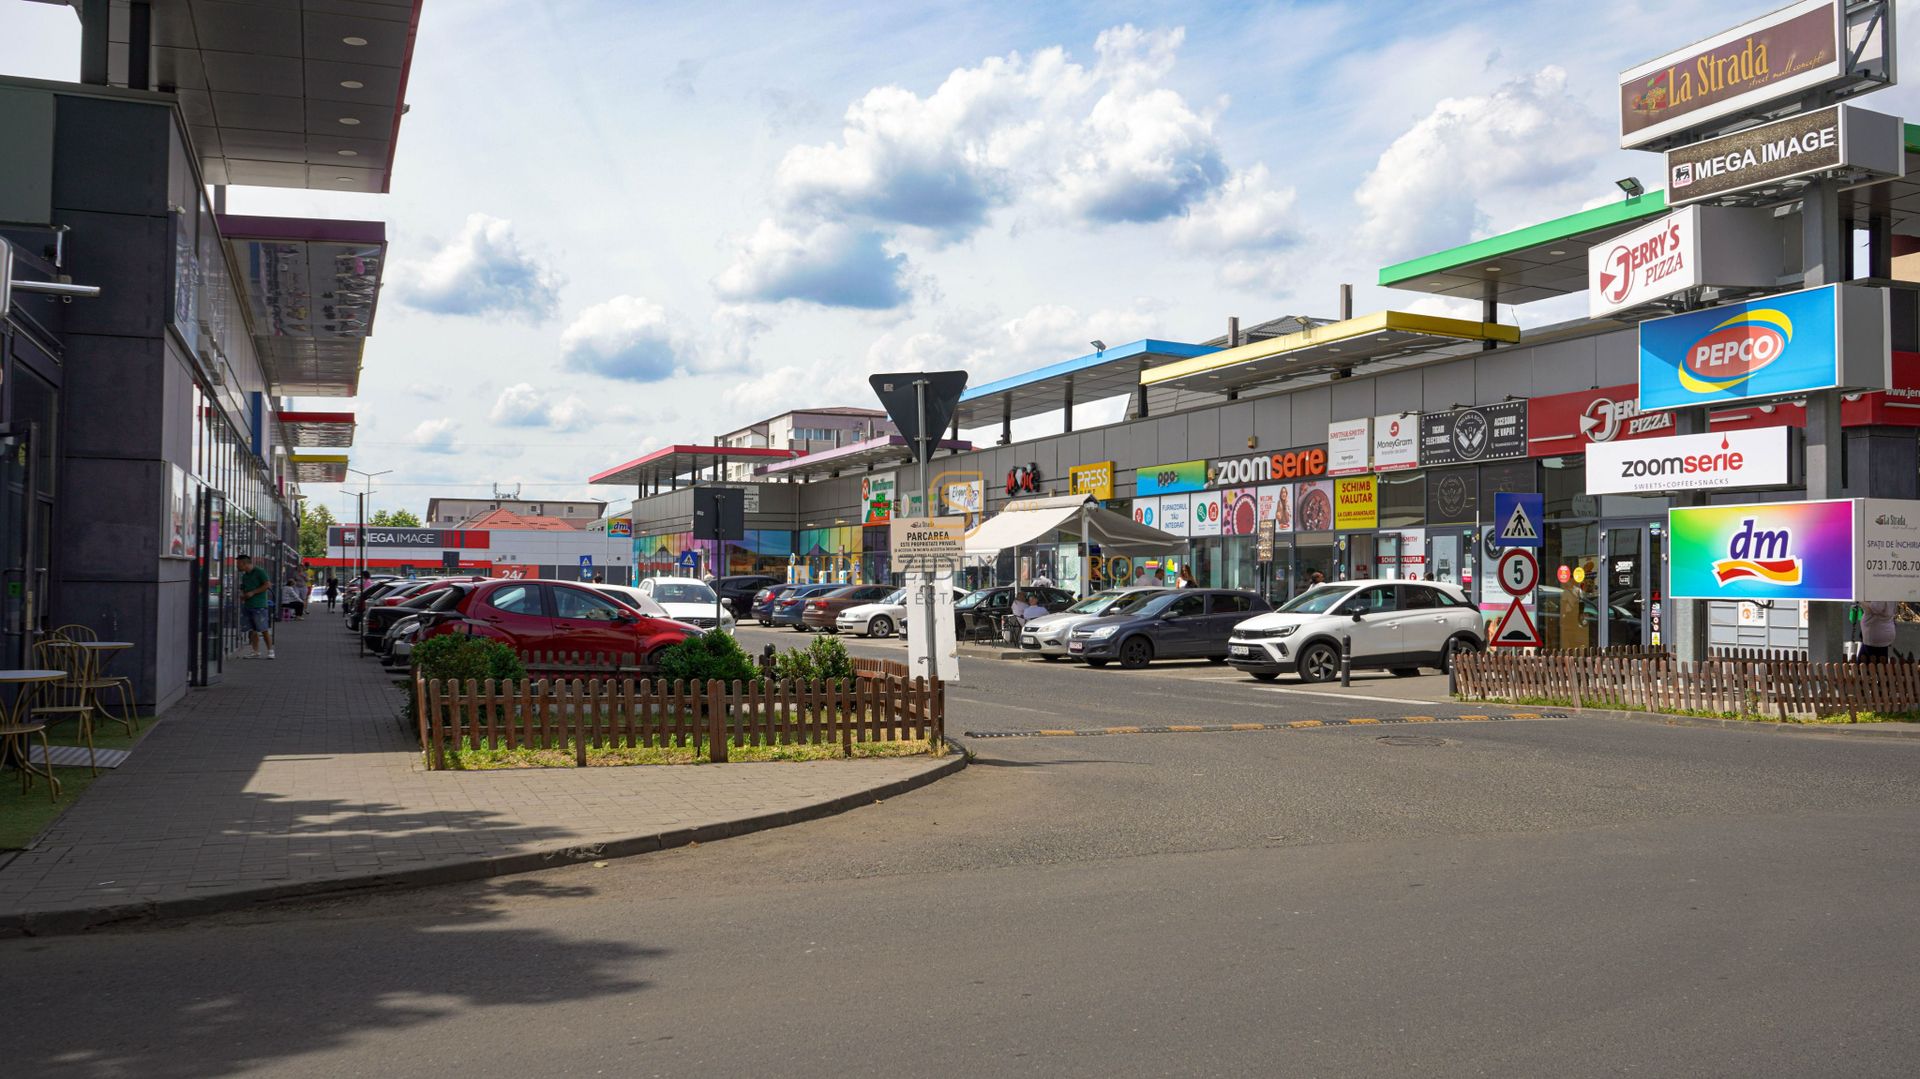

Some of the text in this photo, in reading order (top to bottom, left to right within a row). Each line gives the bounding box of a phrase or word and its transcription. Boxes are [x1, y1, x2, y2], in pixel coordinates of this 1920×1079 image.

[1667, 37, 1769, 108] La Strada
[1695, 126, 1838, 180] MEGA IMAGE
[1614, 220, 1680, 301] JERRY'S
[1645, 251, 1683, 287] PIZZA
[1695, 334, 1774, 369] PEPCO
[1628, 412, 1673, 434] PIZZA
[1377, 438, 1413, 449] MoneyGram
[1218, 447, 1328, 486] zoomserie
[1621, 452, 1743, 478] zoomserie
[1077, 468, 1108, 490] PRESS
[1342, 480, 1371, 494] SCHIMB
[1162, 503, 1188, 511] FURNIZORUL
[1340, 493, 1373, 505] VALUTAR
[614, 522, 626, 530] dm
[906, 531, 950, 541] PARCAREA
[1164, 521, 1184, 529] INTEGRAT
[396, 534, 434, 544] IMAGE
[1730, 519, 1789, 560] dm
[1886, 540, 1894, 548] DE
[1514, 560, 1524, 584] 5
